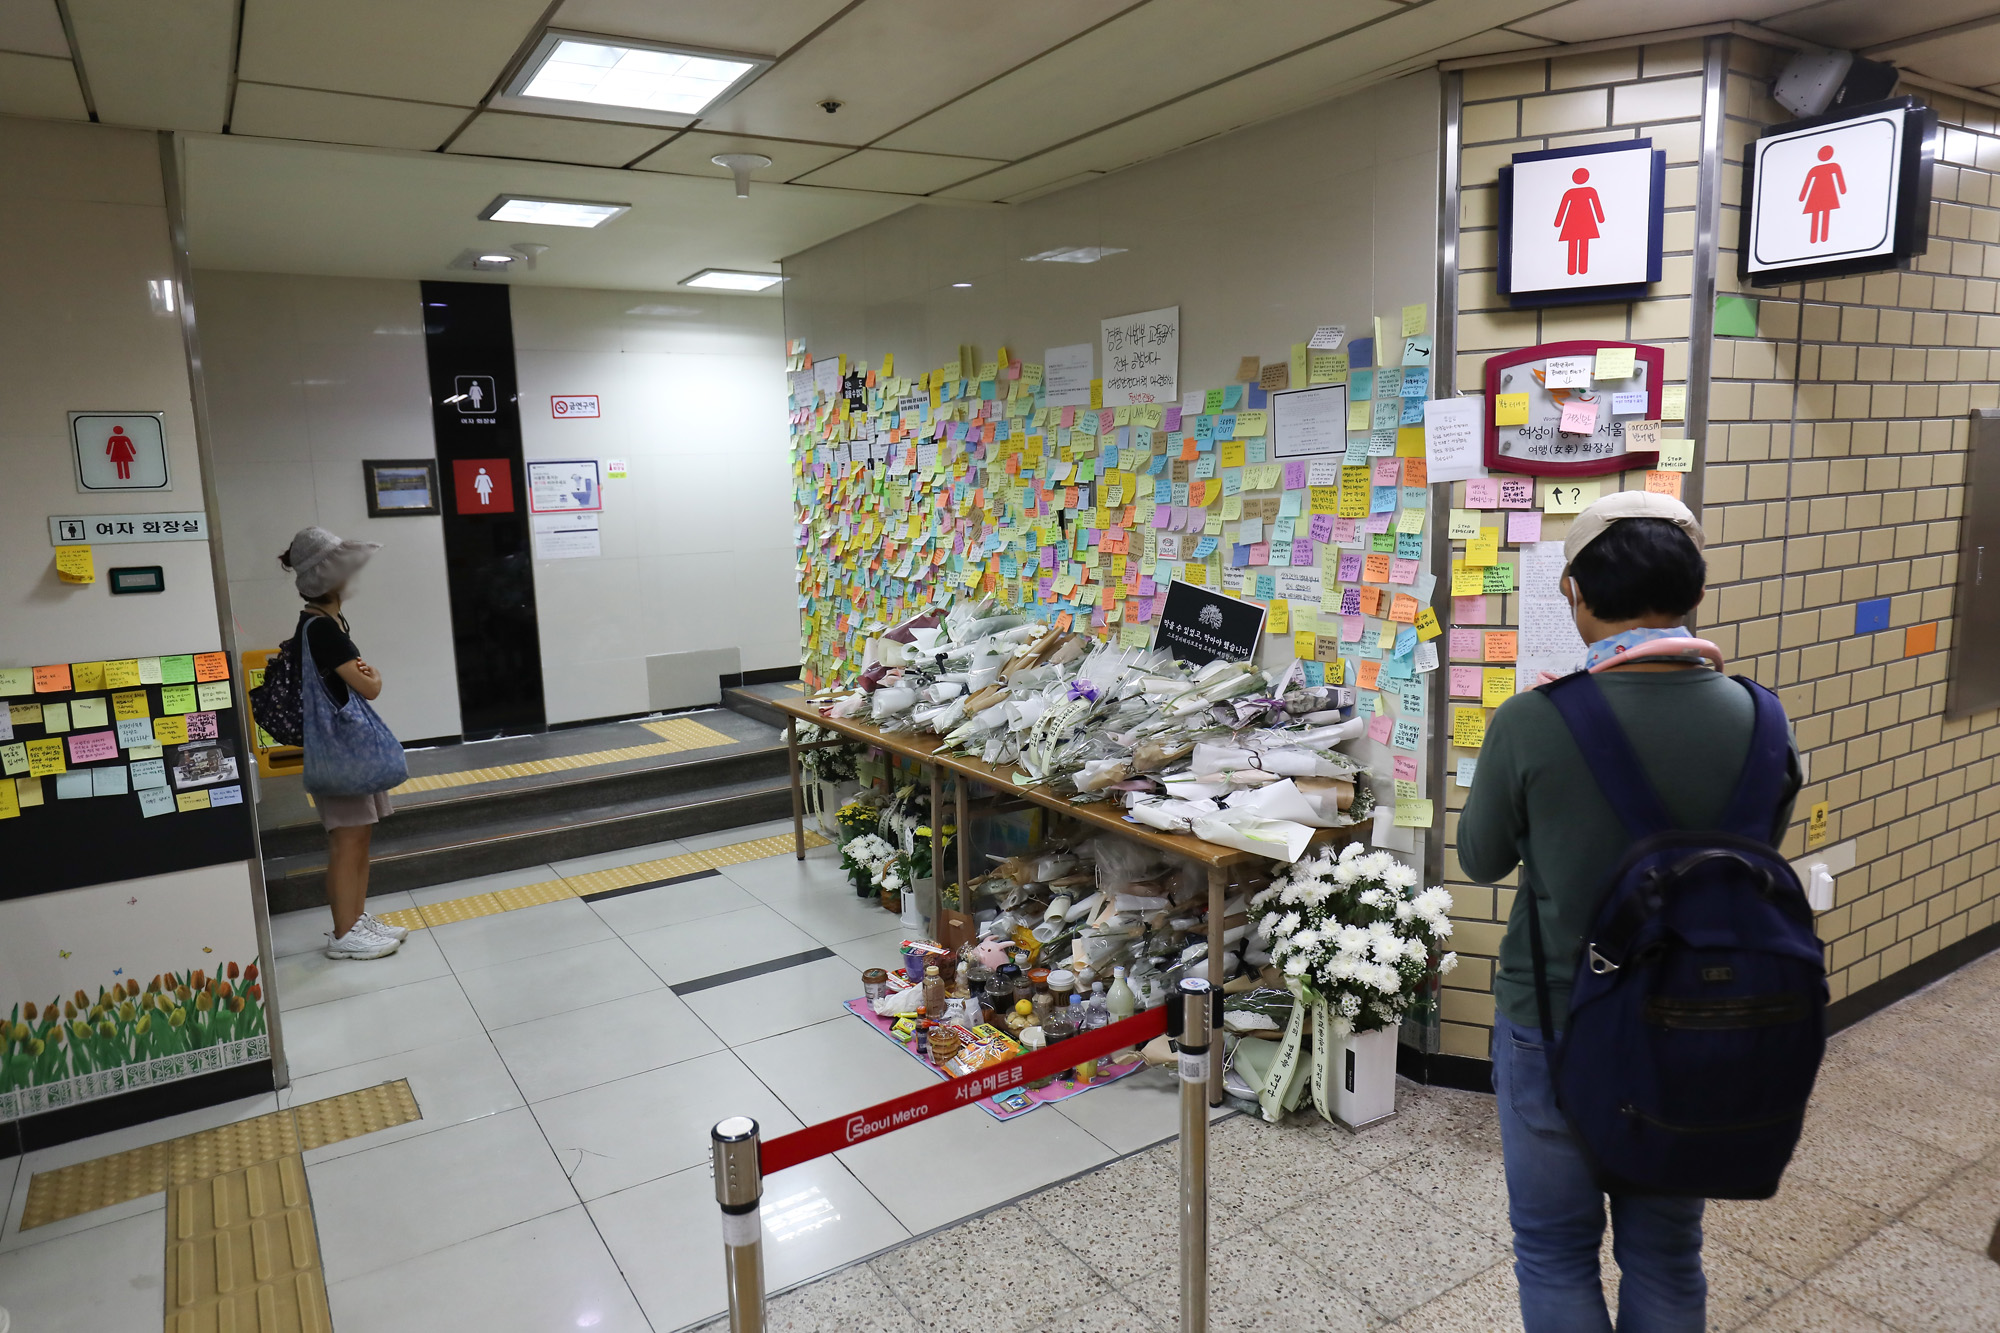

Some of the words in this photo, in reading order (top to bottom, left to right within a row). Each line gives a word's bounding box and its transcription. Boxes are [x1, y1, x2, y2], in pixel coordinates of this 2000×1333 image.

[569, 401, 596, 411] 금연구역
[1565, 412, 1592, 425] 거짓말
[1519, 425, 1554, 440] 여성이
[1598, 422, 1625, 437] 서울
[1582, 442, 1614, 454] 화장실
[1570, 488, 1581, 505] ?
[96, 521, 135, 536] 여자
[143, 519, 199, 534] 화장실
[1163, 619, 1175, 630] 막을
[1175, 624, 1183, 632] 수
[1183, 626, 1202, 641] 있었고,
[1204, 633, 1222, 647] 막아야
[1223, 640, 1249, 656] 했습니다
[955, 1065, 1023, 1100] 서울메트로
[847, 1114, 890, 1141] Seoul
[893, 1105, 928, 1126] Metro
